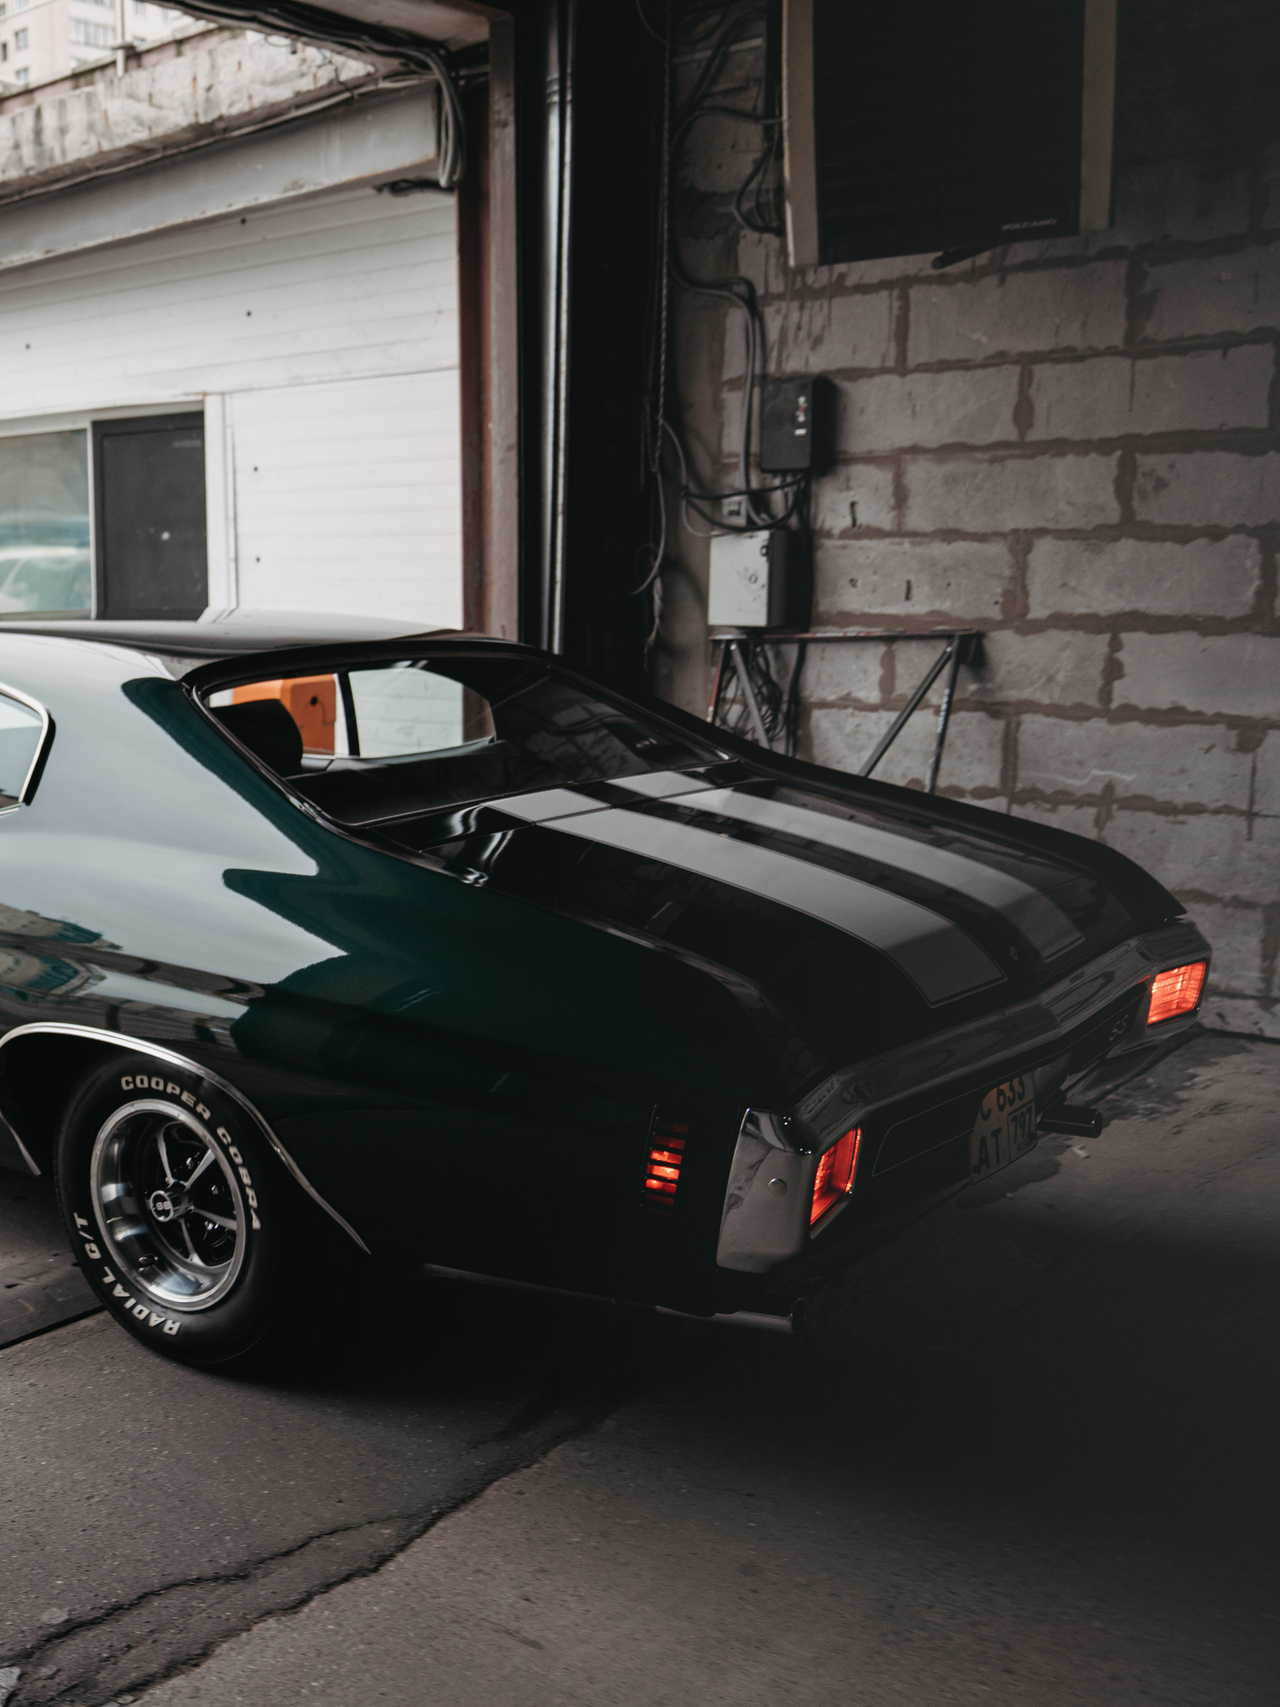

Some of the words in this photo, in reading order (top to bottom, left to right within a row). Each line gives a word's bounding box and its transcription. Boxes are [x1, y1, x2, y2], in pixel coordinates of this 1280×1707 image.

[1109, 1013, 1129, 1041] SS
[121, 1074, 212, 1121] COOPER
[216, 1126, 262, 1231] COBRA
[73, 1211, 102, 1260] G/T
[102, 1266, 182, 1336] RADIAL
